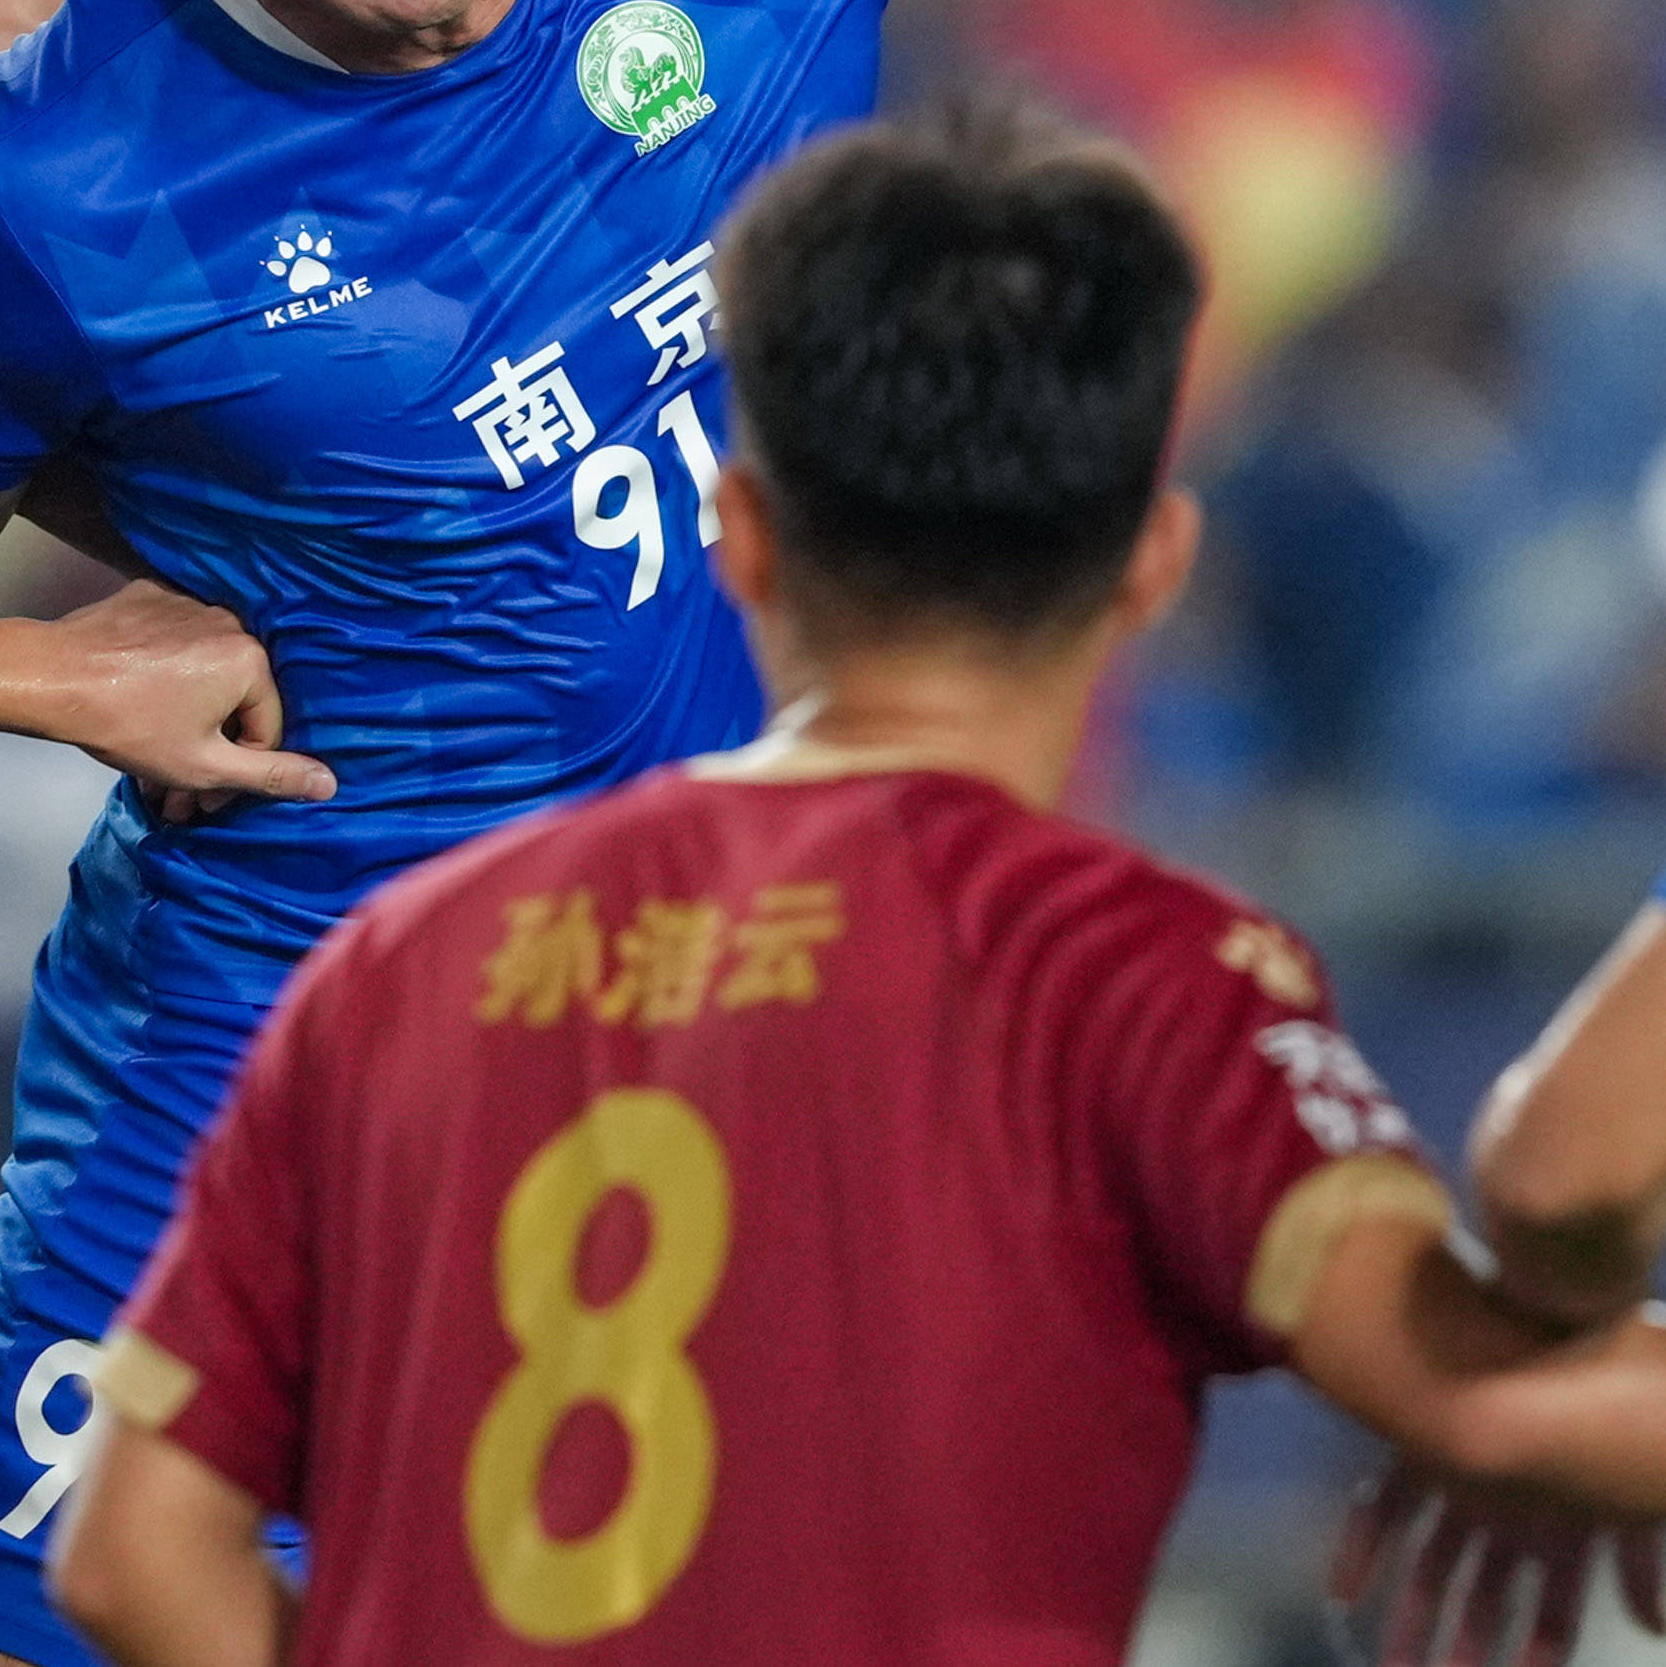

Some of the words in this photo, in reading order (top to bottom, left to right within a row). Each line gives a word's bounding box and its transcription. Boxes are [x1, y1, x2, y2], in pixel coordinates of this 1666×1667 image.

[636, 95, 715, 156] NANJING
[264, 277, 373, 328] KELME
[452, 240, 725, 490] 南京
[572, 390, 725, 611] 91
[465, 1087, 732, 1646] 8
